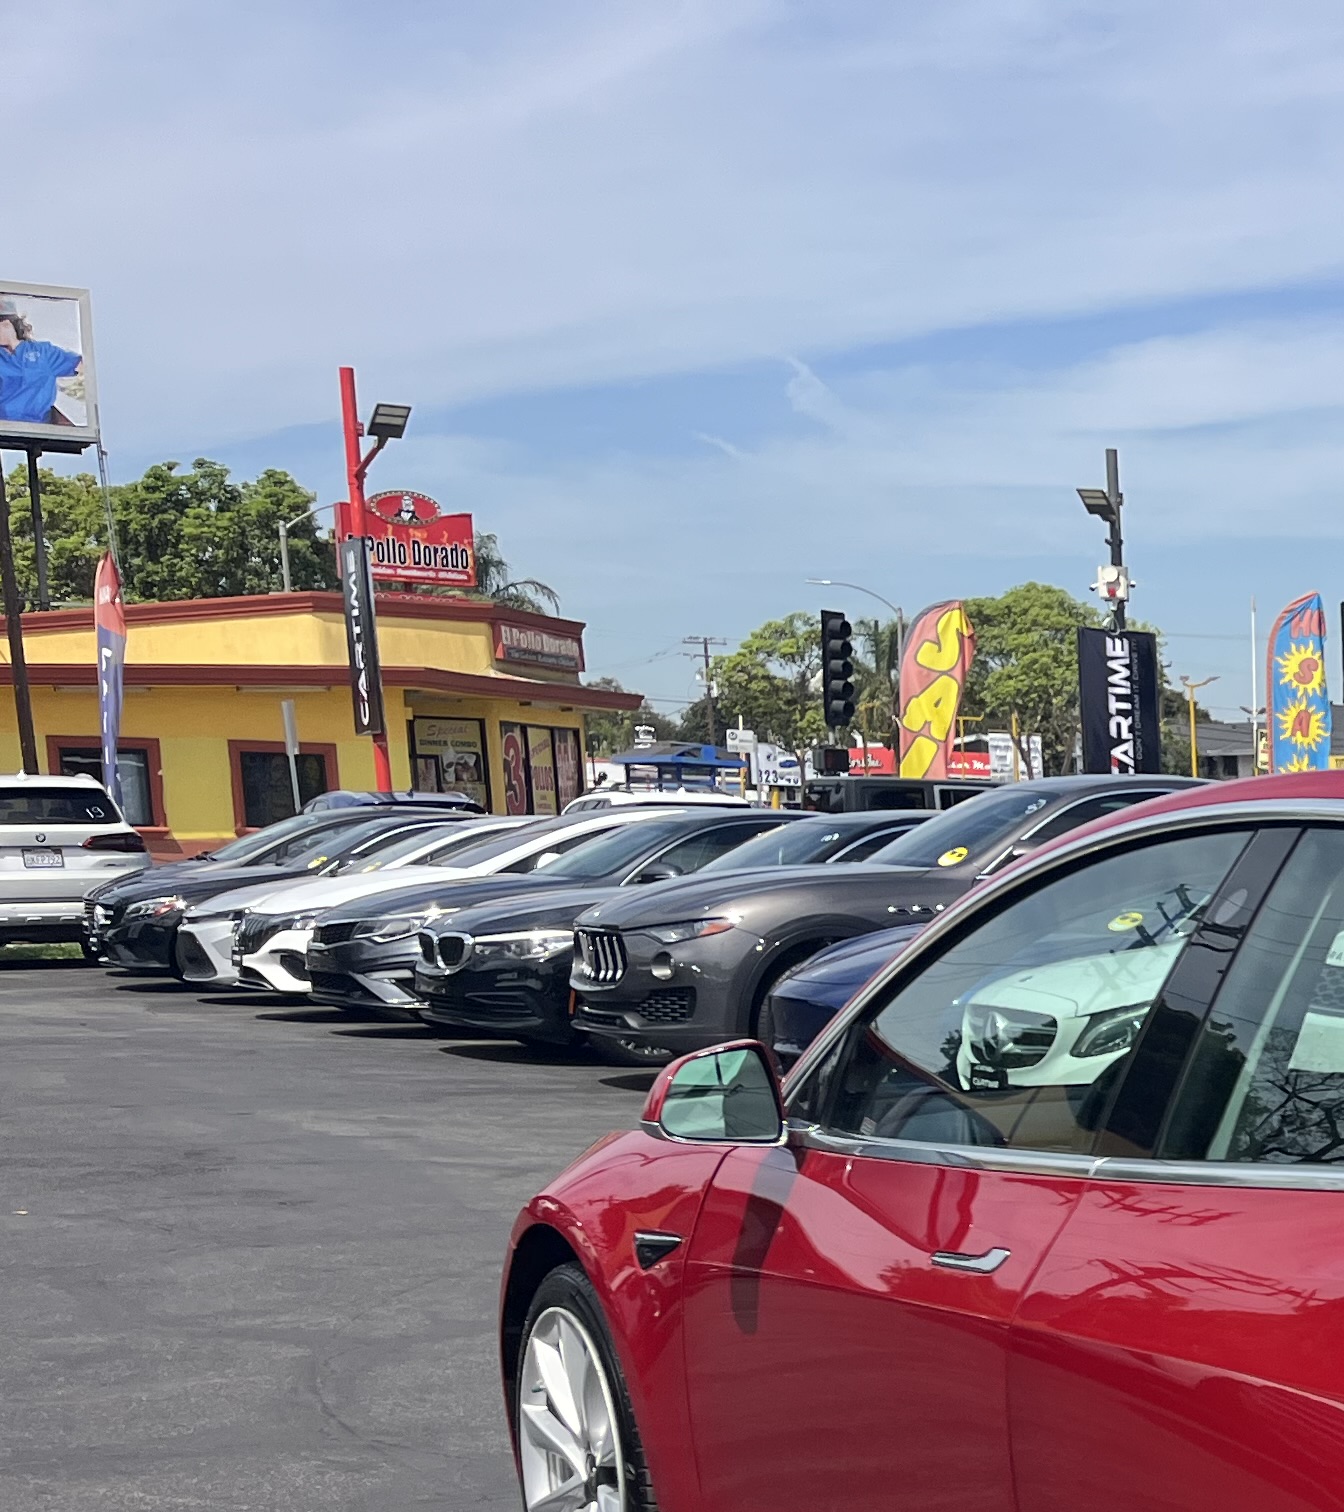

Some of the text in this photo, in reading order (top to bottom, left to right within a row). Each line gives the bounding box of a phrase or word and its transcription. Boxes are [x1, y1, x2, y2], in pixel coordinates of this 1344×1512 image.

[411, 539, 469, 570] Dorado
[346, 549, 370, 726] CARTIME
[500, 625, 579, 657] El Pollo Dorado
[451, 739, 478, 748] COMBO
